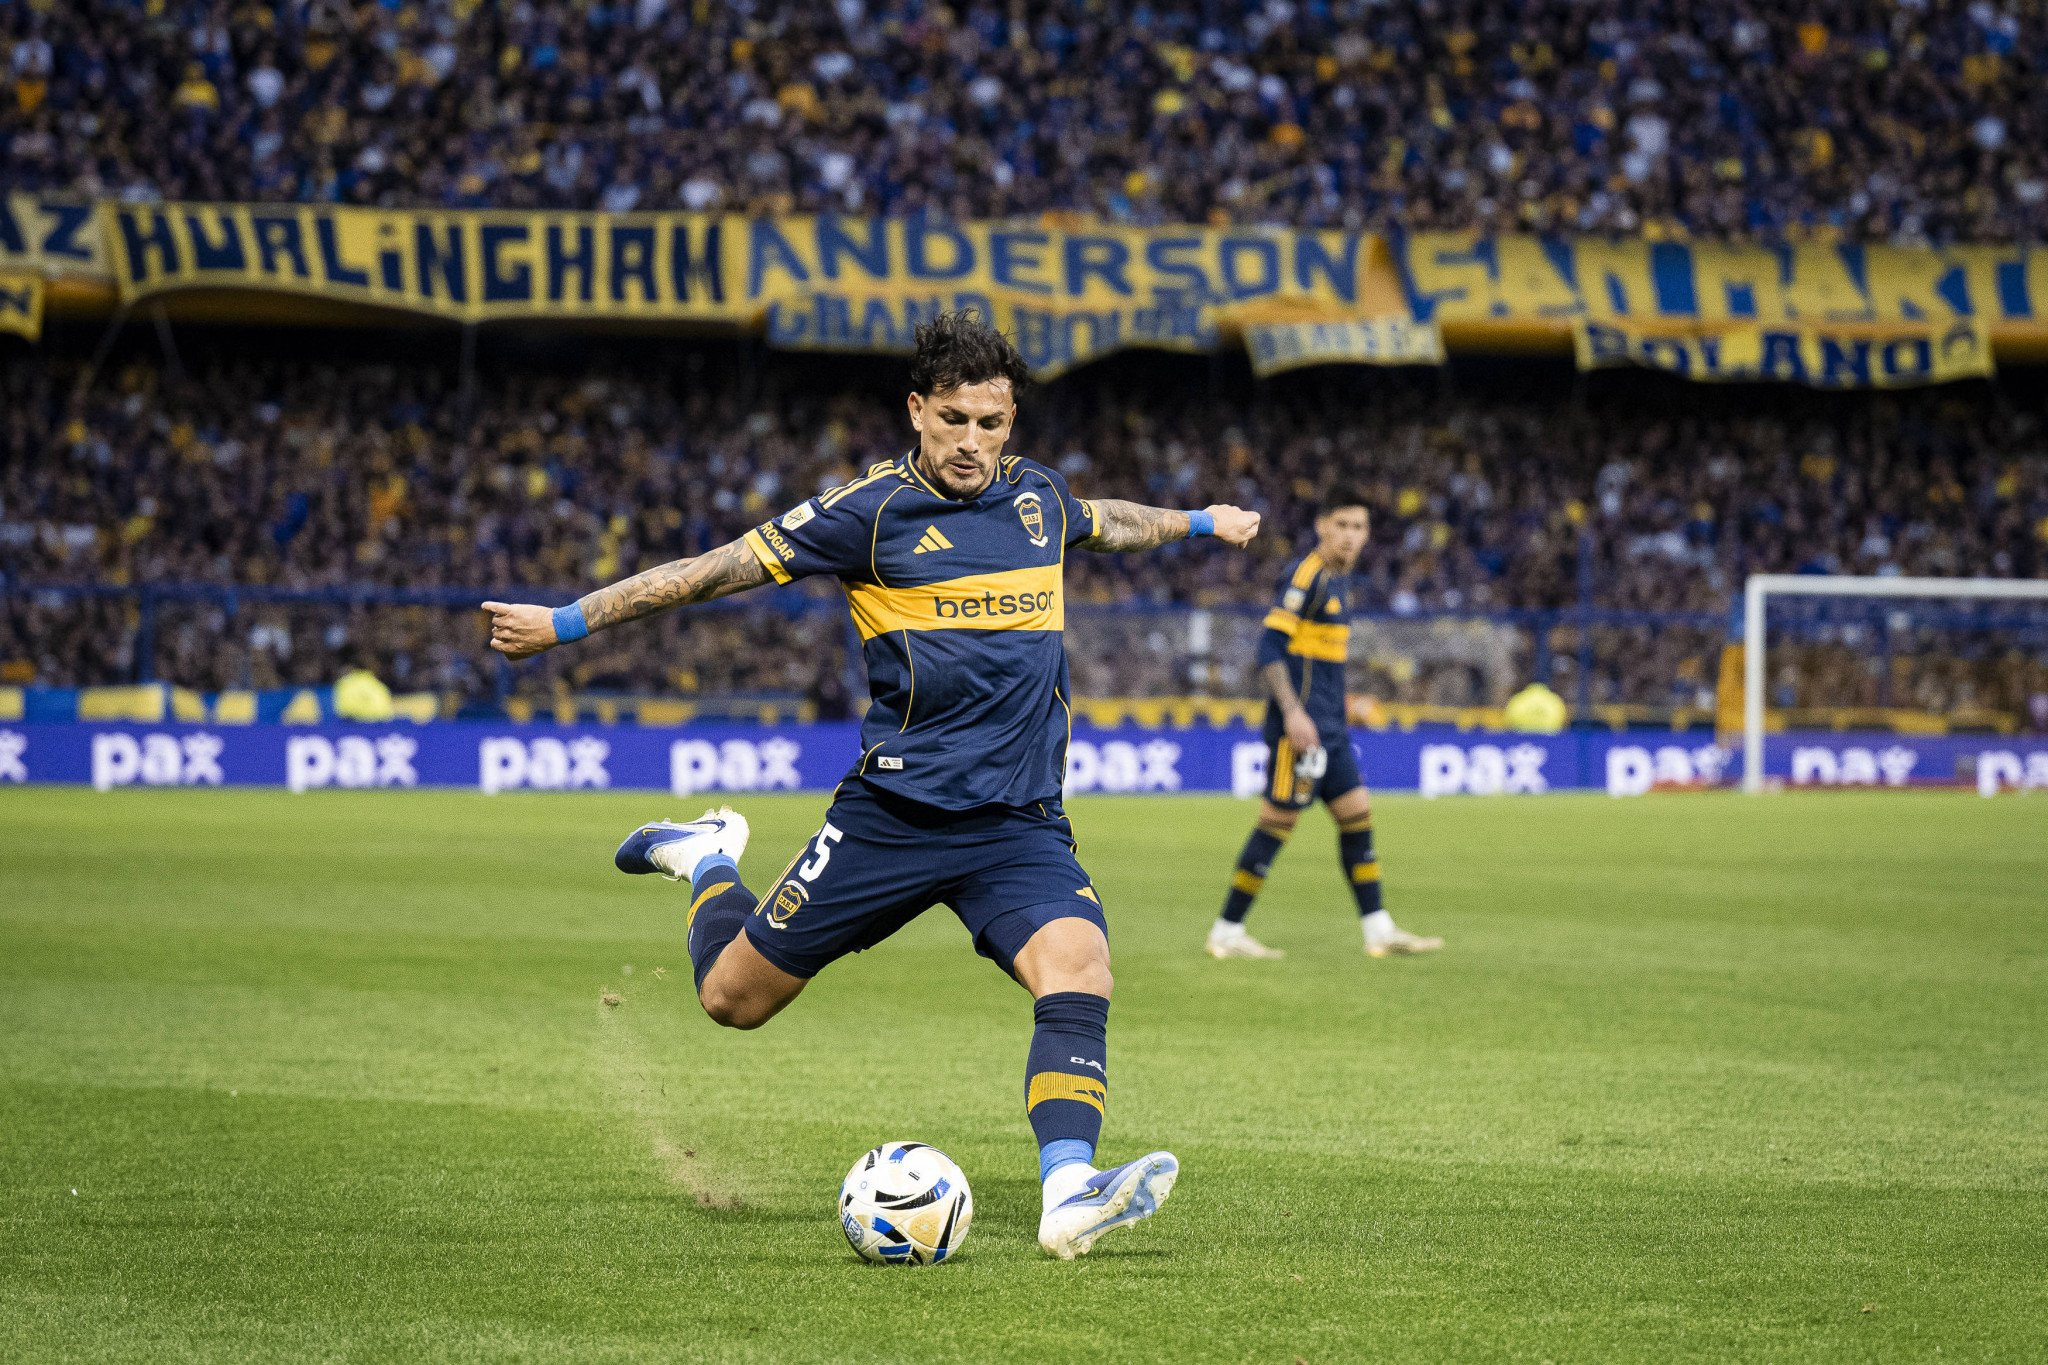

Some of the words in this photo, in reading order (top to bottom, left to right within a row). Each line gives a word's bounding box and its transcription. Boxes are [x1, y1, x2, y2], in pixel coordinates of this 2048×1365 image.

[746, 214, 1361, 300] ANDERSON
[760, 520, 796, 562] ROGAR
[91, 732, 225, 793] pax
[285, 733, 419, 794] pax
[479, 735, 611, 796] pax
[669, 737, 801, 798] pax
[1419, 743, 1548, 800] pax
[798, 822, 844, 883] 5
